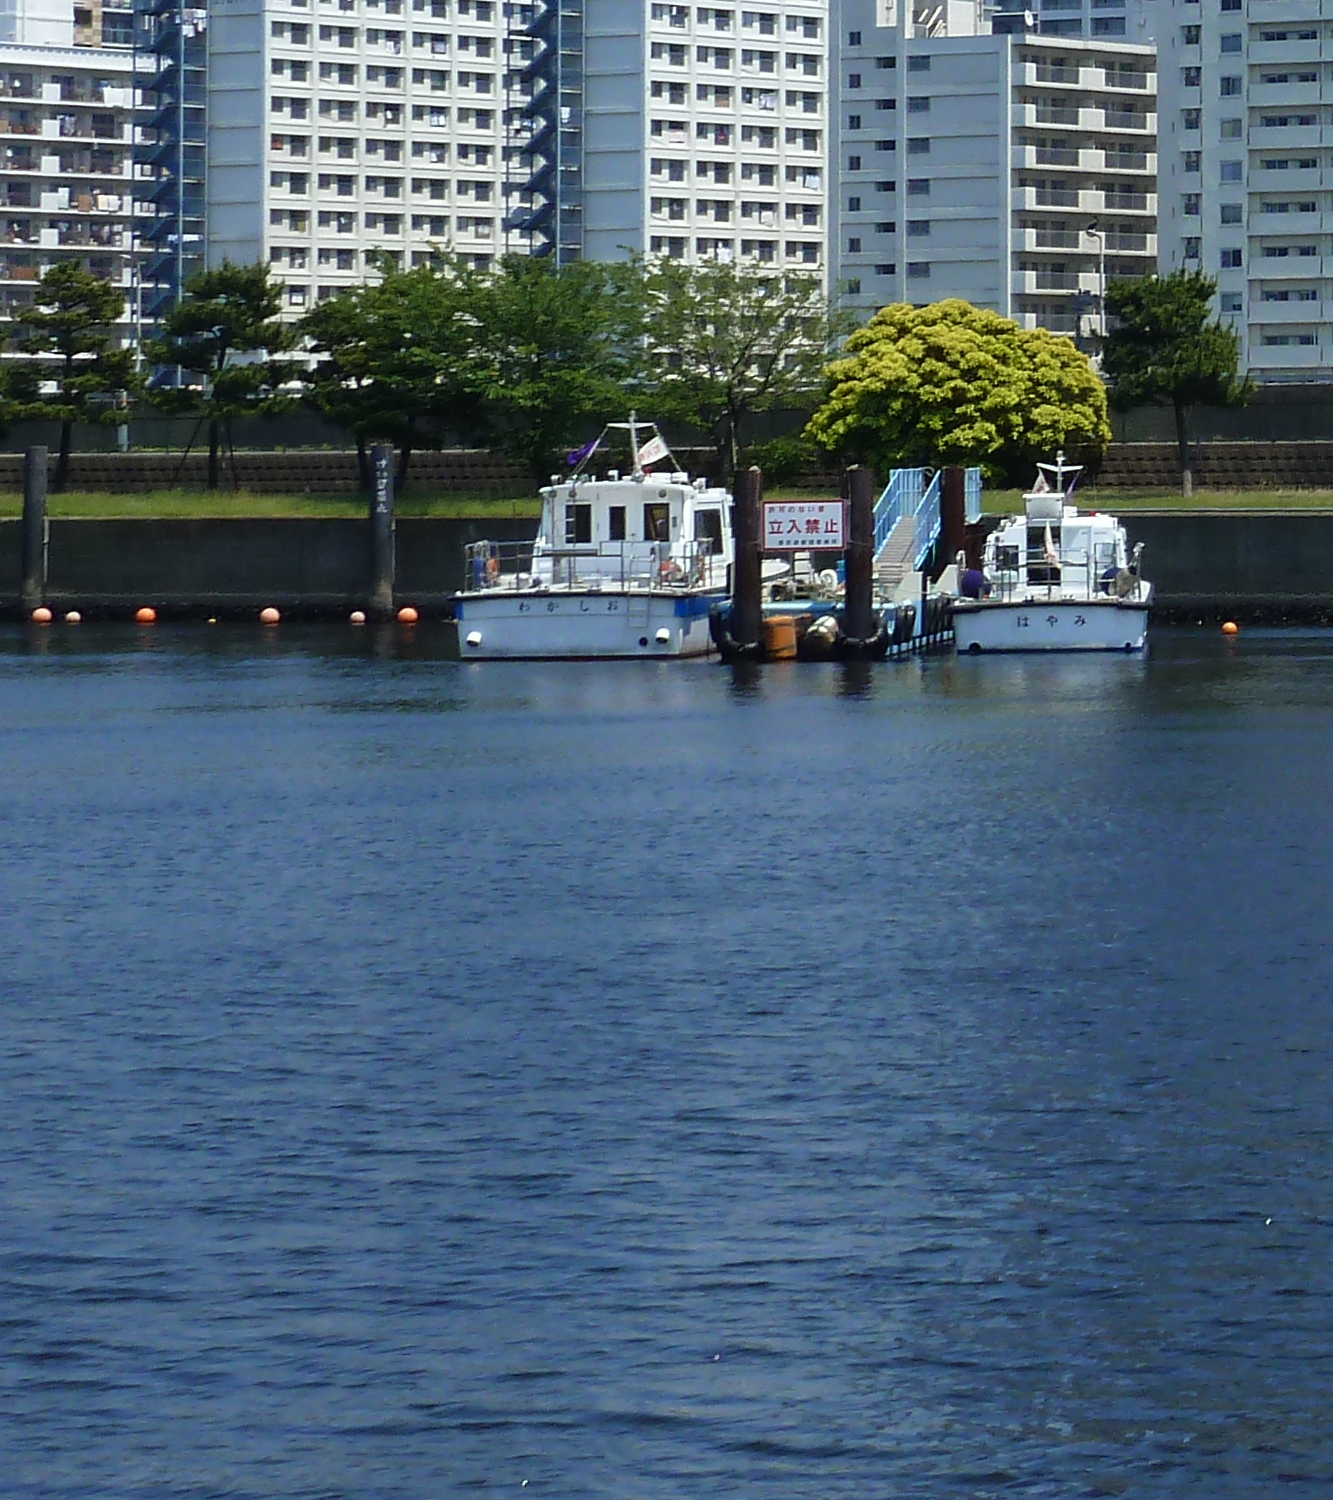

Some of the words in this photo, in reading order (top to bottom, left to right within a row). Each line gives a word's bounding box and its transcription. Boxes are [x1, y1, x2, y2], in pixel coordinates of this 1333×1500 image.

[768, 518, 838, 534] 立入禁止
[519, 600, 619, 613] わかしお
[1017, 615, 1086, 627] はやみ
